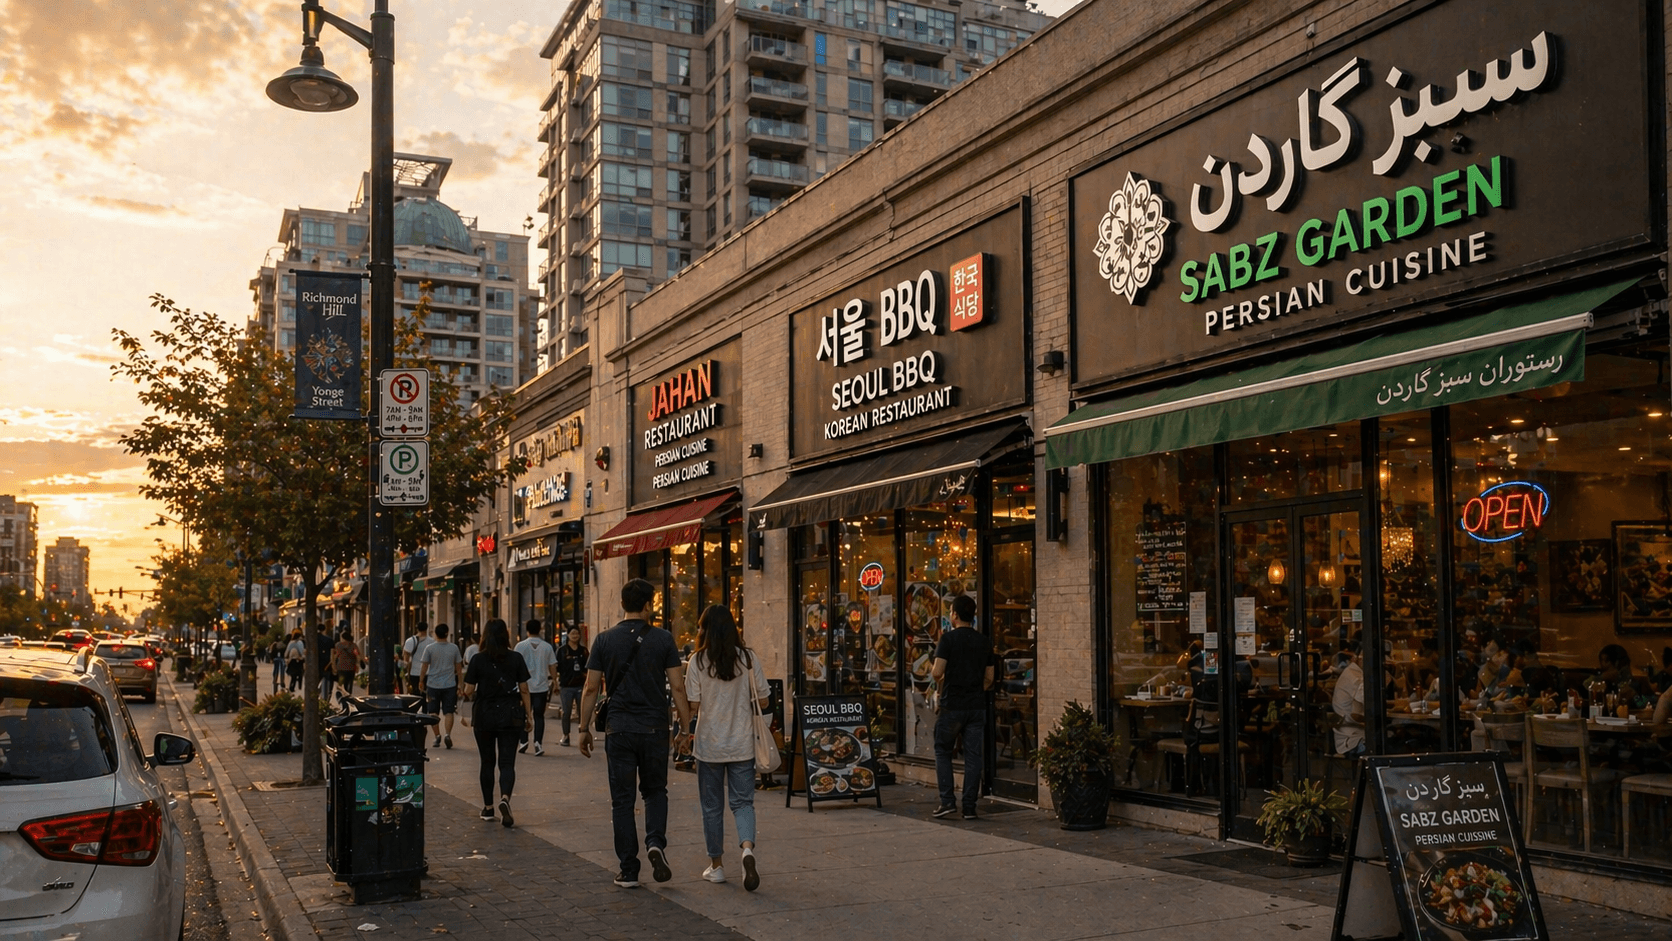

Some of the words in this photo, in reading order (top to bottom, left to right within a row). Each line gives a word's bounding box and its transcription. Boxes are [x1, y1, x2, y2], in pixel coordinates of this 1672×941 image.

[1372, 31, 1550, 175] سبز
[1190, 56, 1360, 232] گاردن
[1180, 231, 1279, 303] SABZ
[1295, 155, 1502, 266] GARDEN
[953, 263, 979, 294] 한국
[1205, 279, 1324, 335] PERSIAN
[1345, 231, 1486, 295] CUISINE
[302, 291, 357, 304] Richmond
[322, 303, 347, 318] Hill
[953, 291, 979, 320] 식당
[816, 298, 866, 367] 서울
[880, 269, 937, 347] BBQ
[831, 367, 888, 411] SEOUL
[892, 350, 936, 392] BBQ
[1376, 367, 1432, 405] گاردن
[1433, 371, 1472, 397] سبز
[1479, 353, 1564, 387] رستوران
[312, 385, 345, 398] Yonge
[312, 397, 344, 407] Street
[647, 360, 712, 422] JAHAN
[644, 402, 717, 450] RESTAURANT
[824, 412, 868, 440] KOREAN
[872, 385, 952, 427] RESTAURANT
[1463, 492, 1544, 533] OPEN
[803, 704, 838, 716] SEOUL
[840, 702, 863, 714] BBQ
[1400, 811, 1440, 828] SABZ
[1441, 808, 1500, 826] GARDEN
[1415, 832, 1456, 846] PERSIAN
